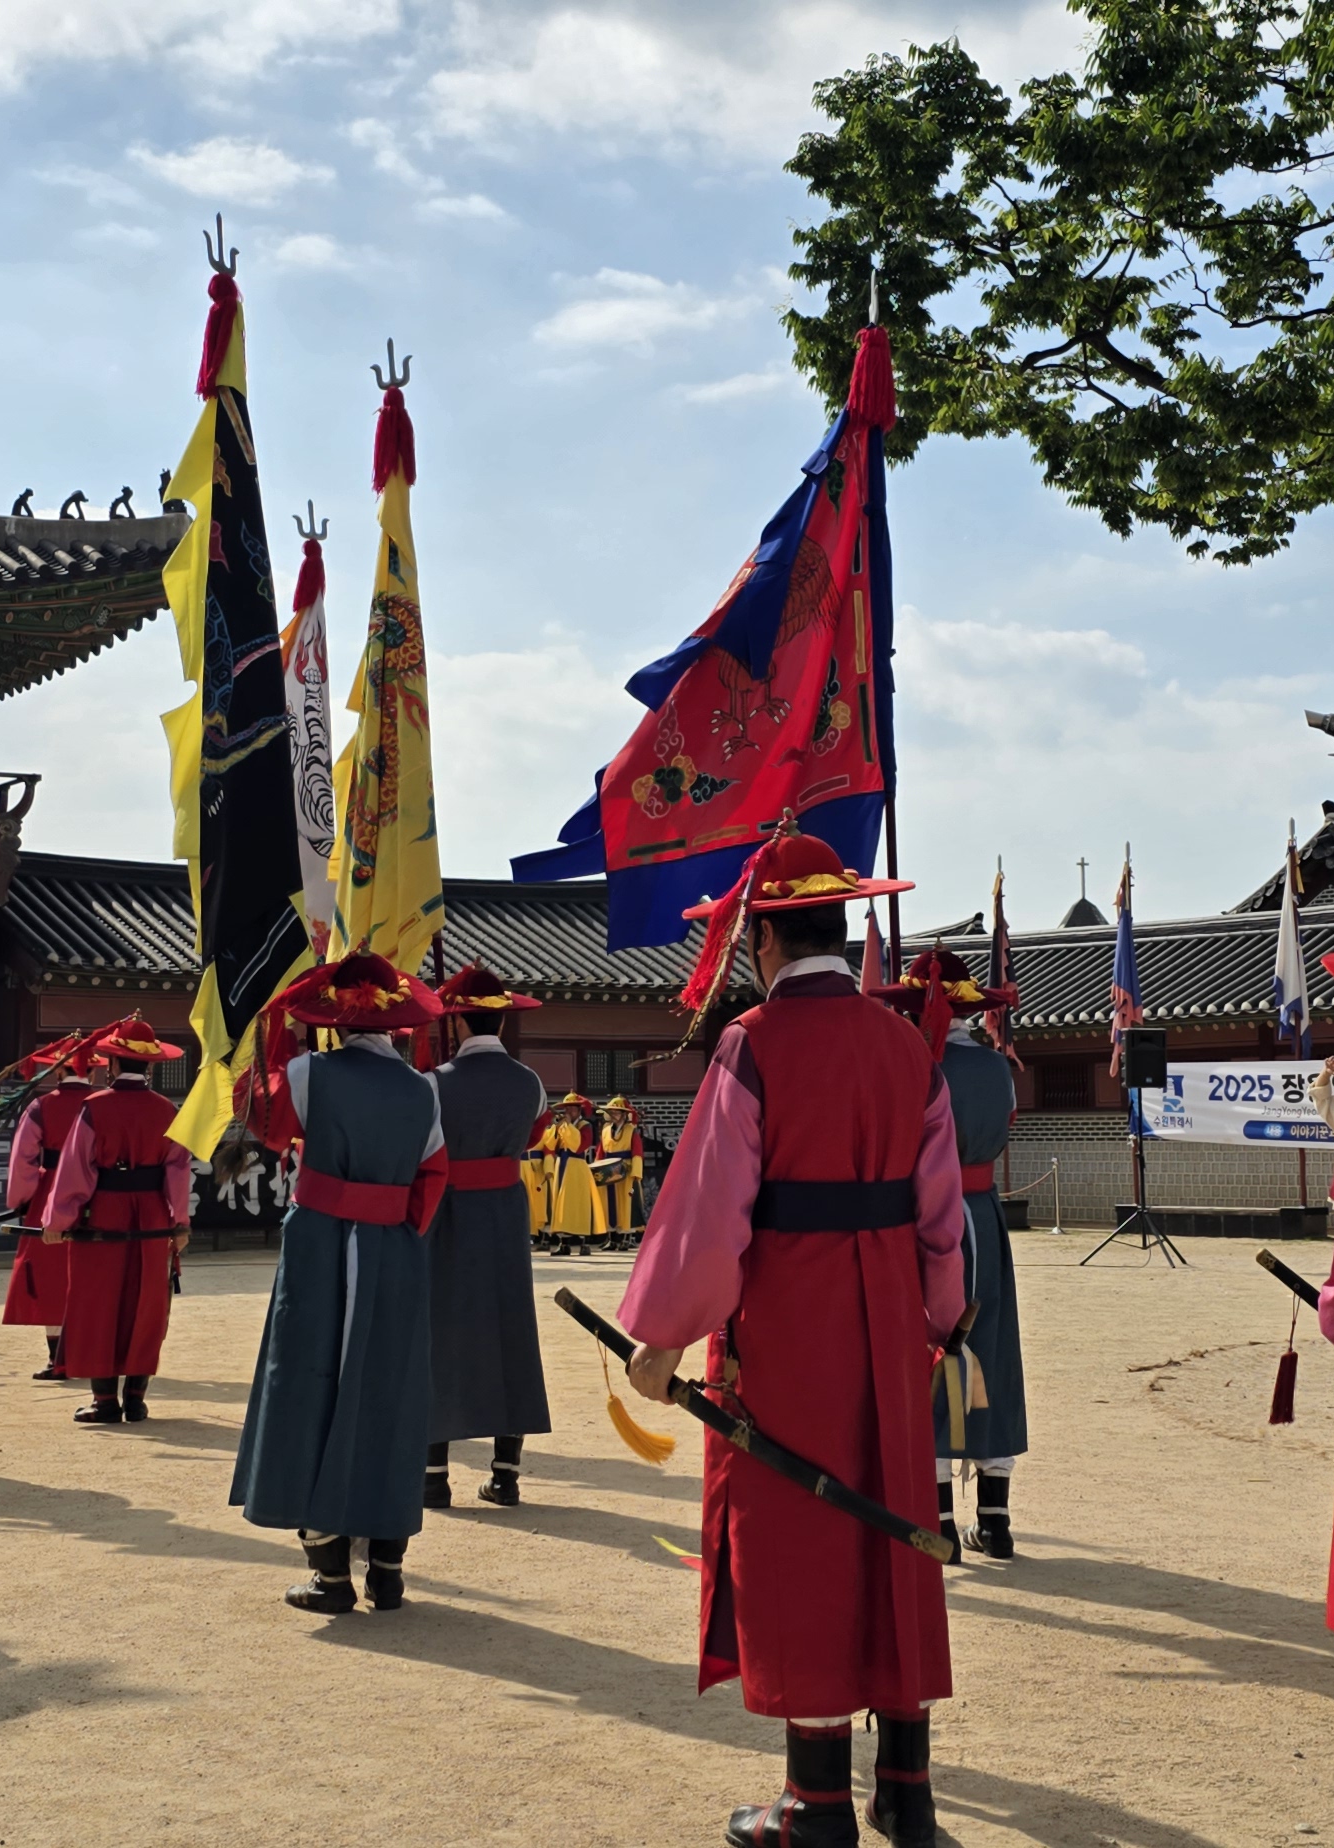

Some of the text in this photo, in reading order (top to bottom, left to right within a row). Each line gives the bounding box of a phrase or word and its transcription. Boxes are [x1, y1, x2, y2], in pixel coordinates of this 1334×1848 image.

[1208, 1074, 1275, 1103] 2025
[1261, 1105, 1318, 1119] JangYongYeo
[1153, 1115, 1194, 1129] 수원특례시
